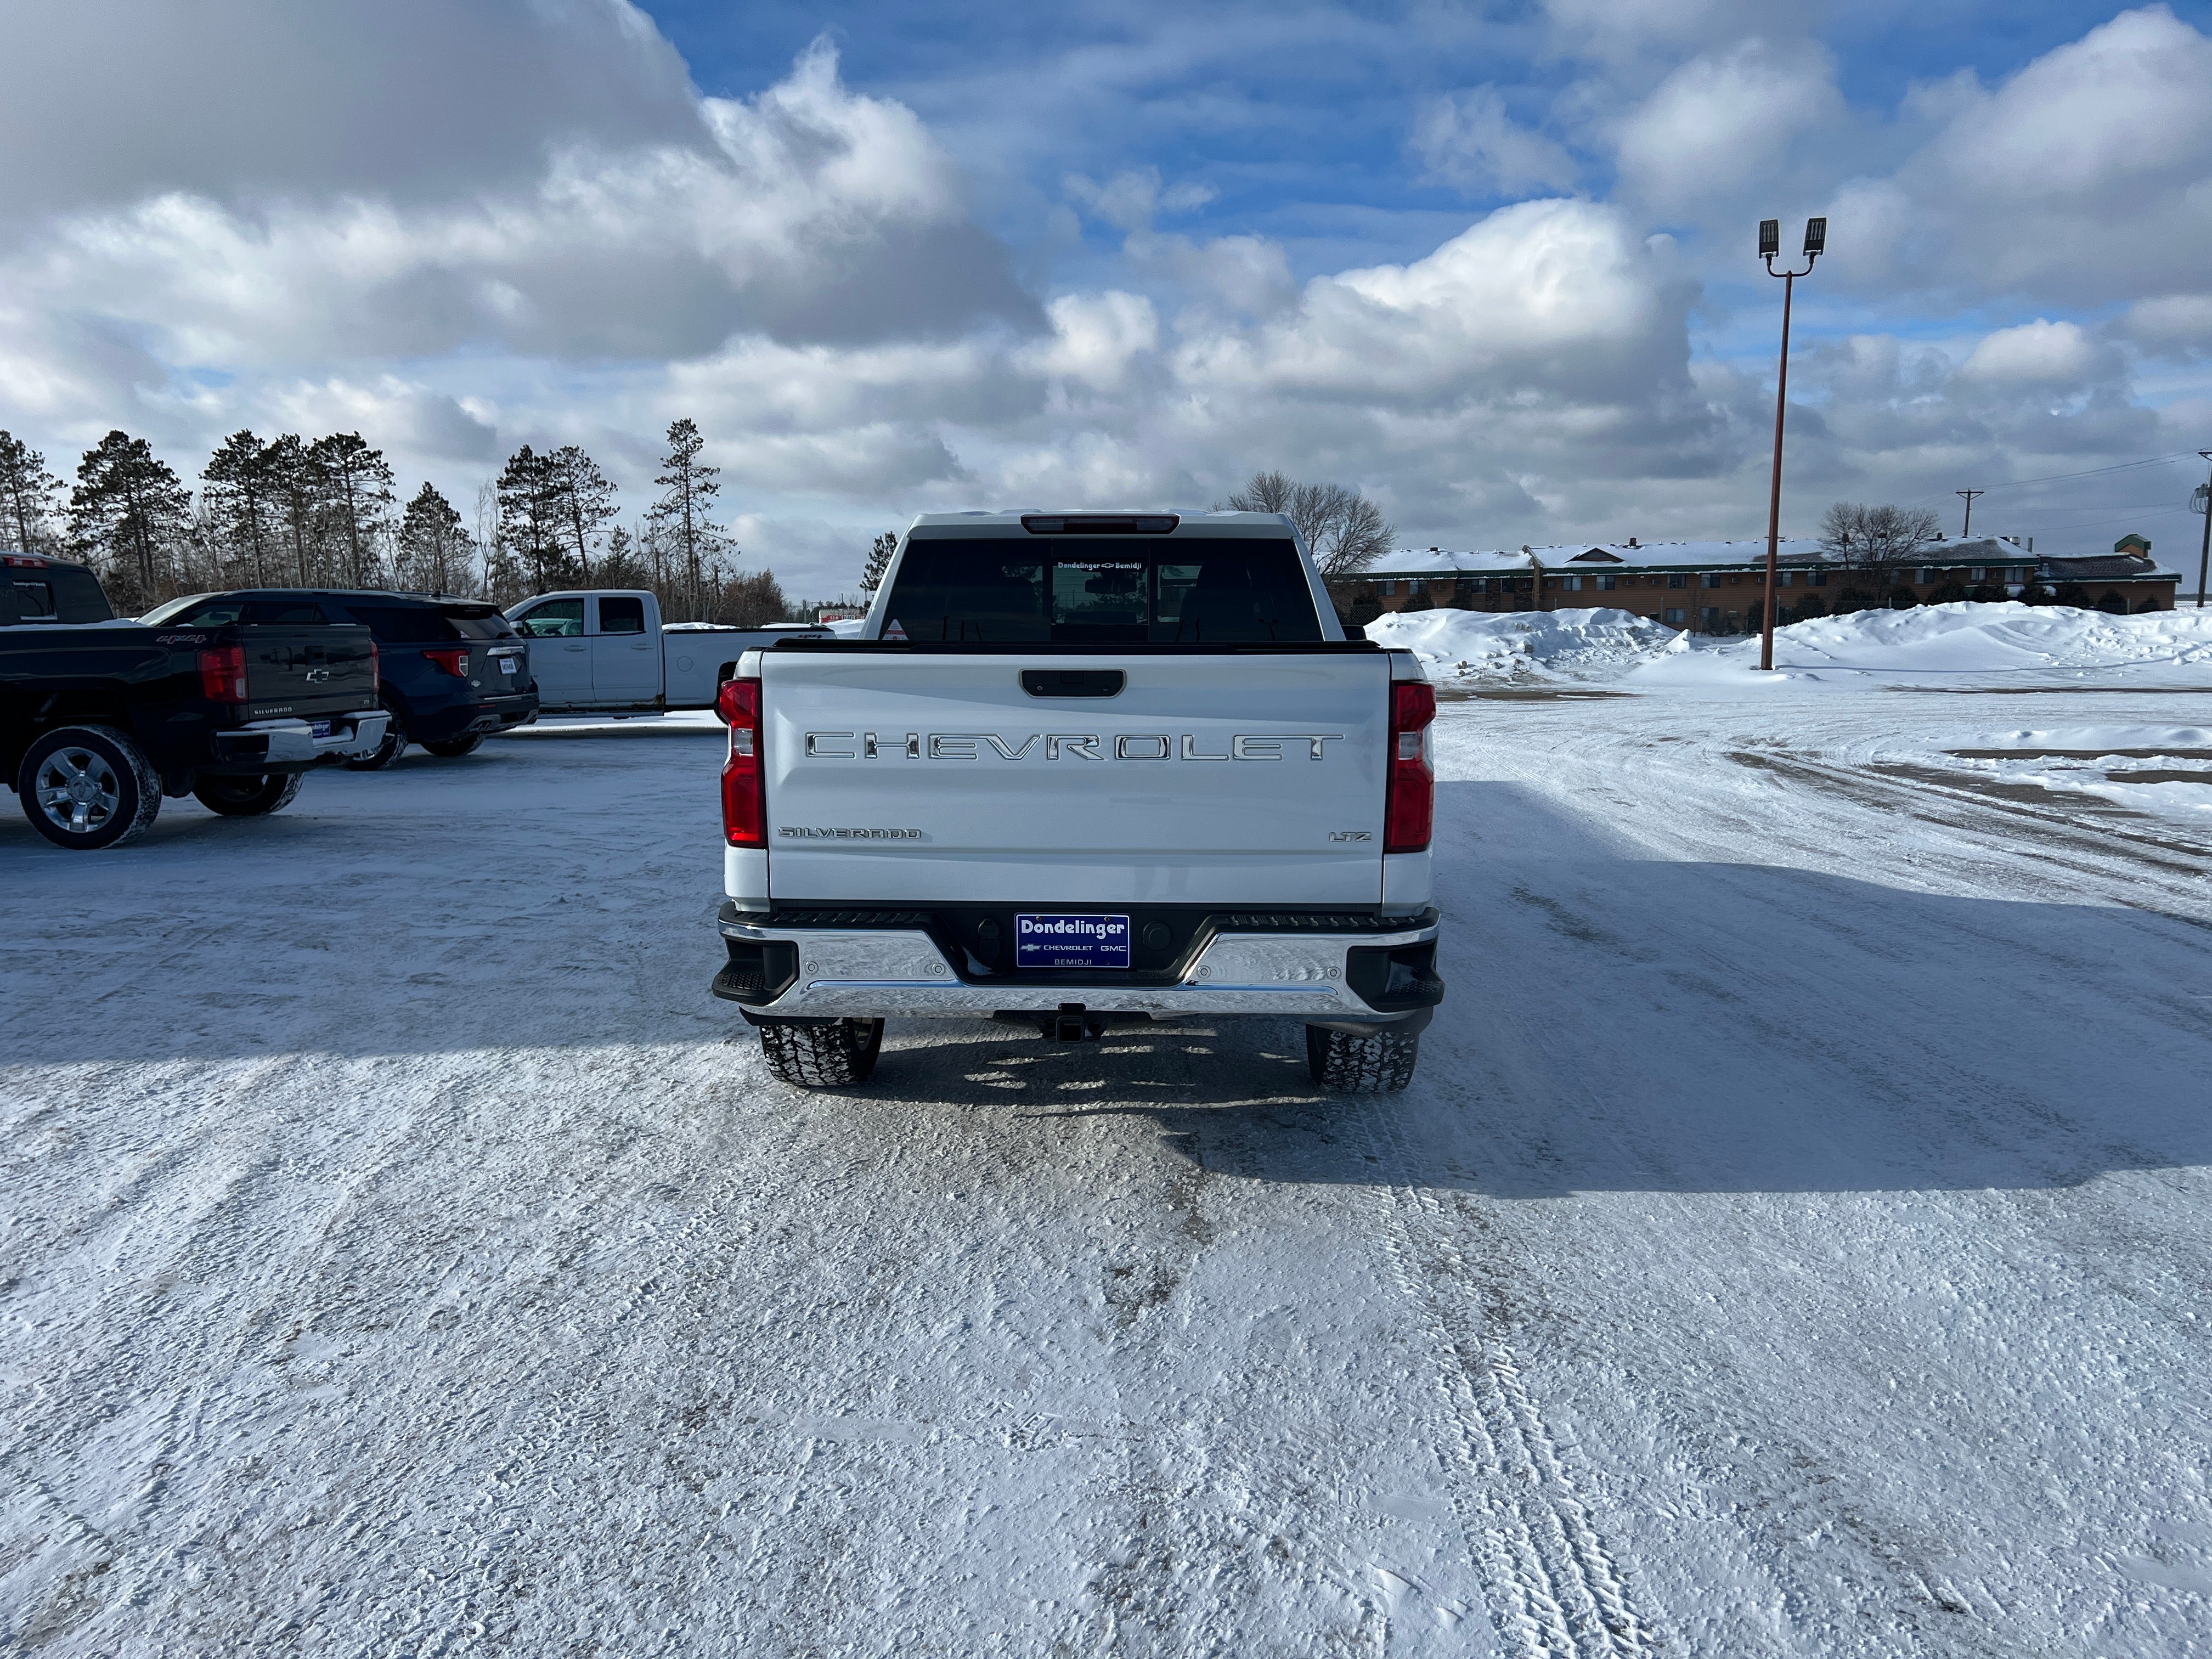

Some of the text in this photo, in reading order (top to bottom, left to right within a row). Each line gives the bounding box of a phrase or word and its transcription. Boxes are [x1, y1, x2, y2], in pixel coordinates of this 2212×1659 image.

[1058, 562, 1100, 571] Dondelinger
[254, 706, 292, 715] SILVERADO
[805, 732, 1345, 761] CHEVROLET
[778, 827, 922, 839] SILVERADO
[1329, 832, 1372, 842] LTZ
[1021, 919, 1125, 940] Dondelinger
